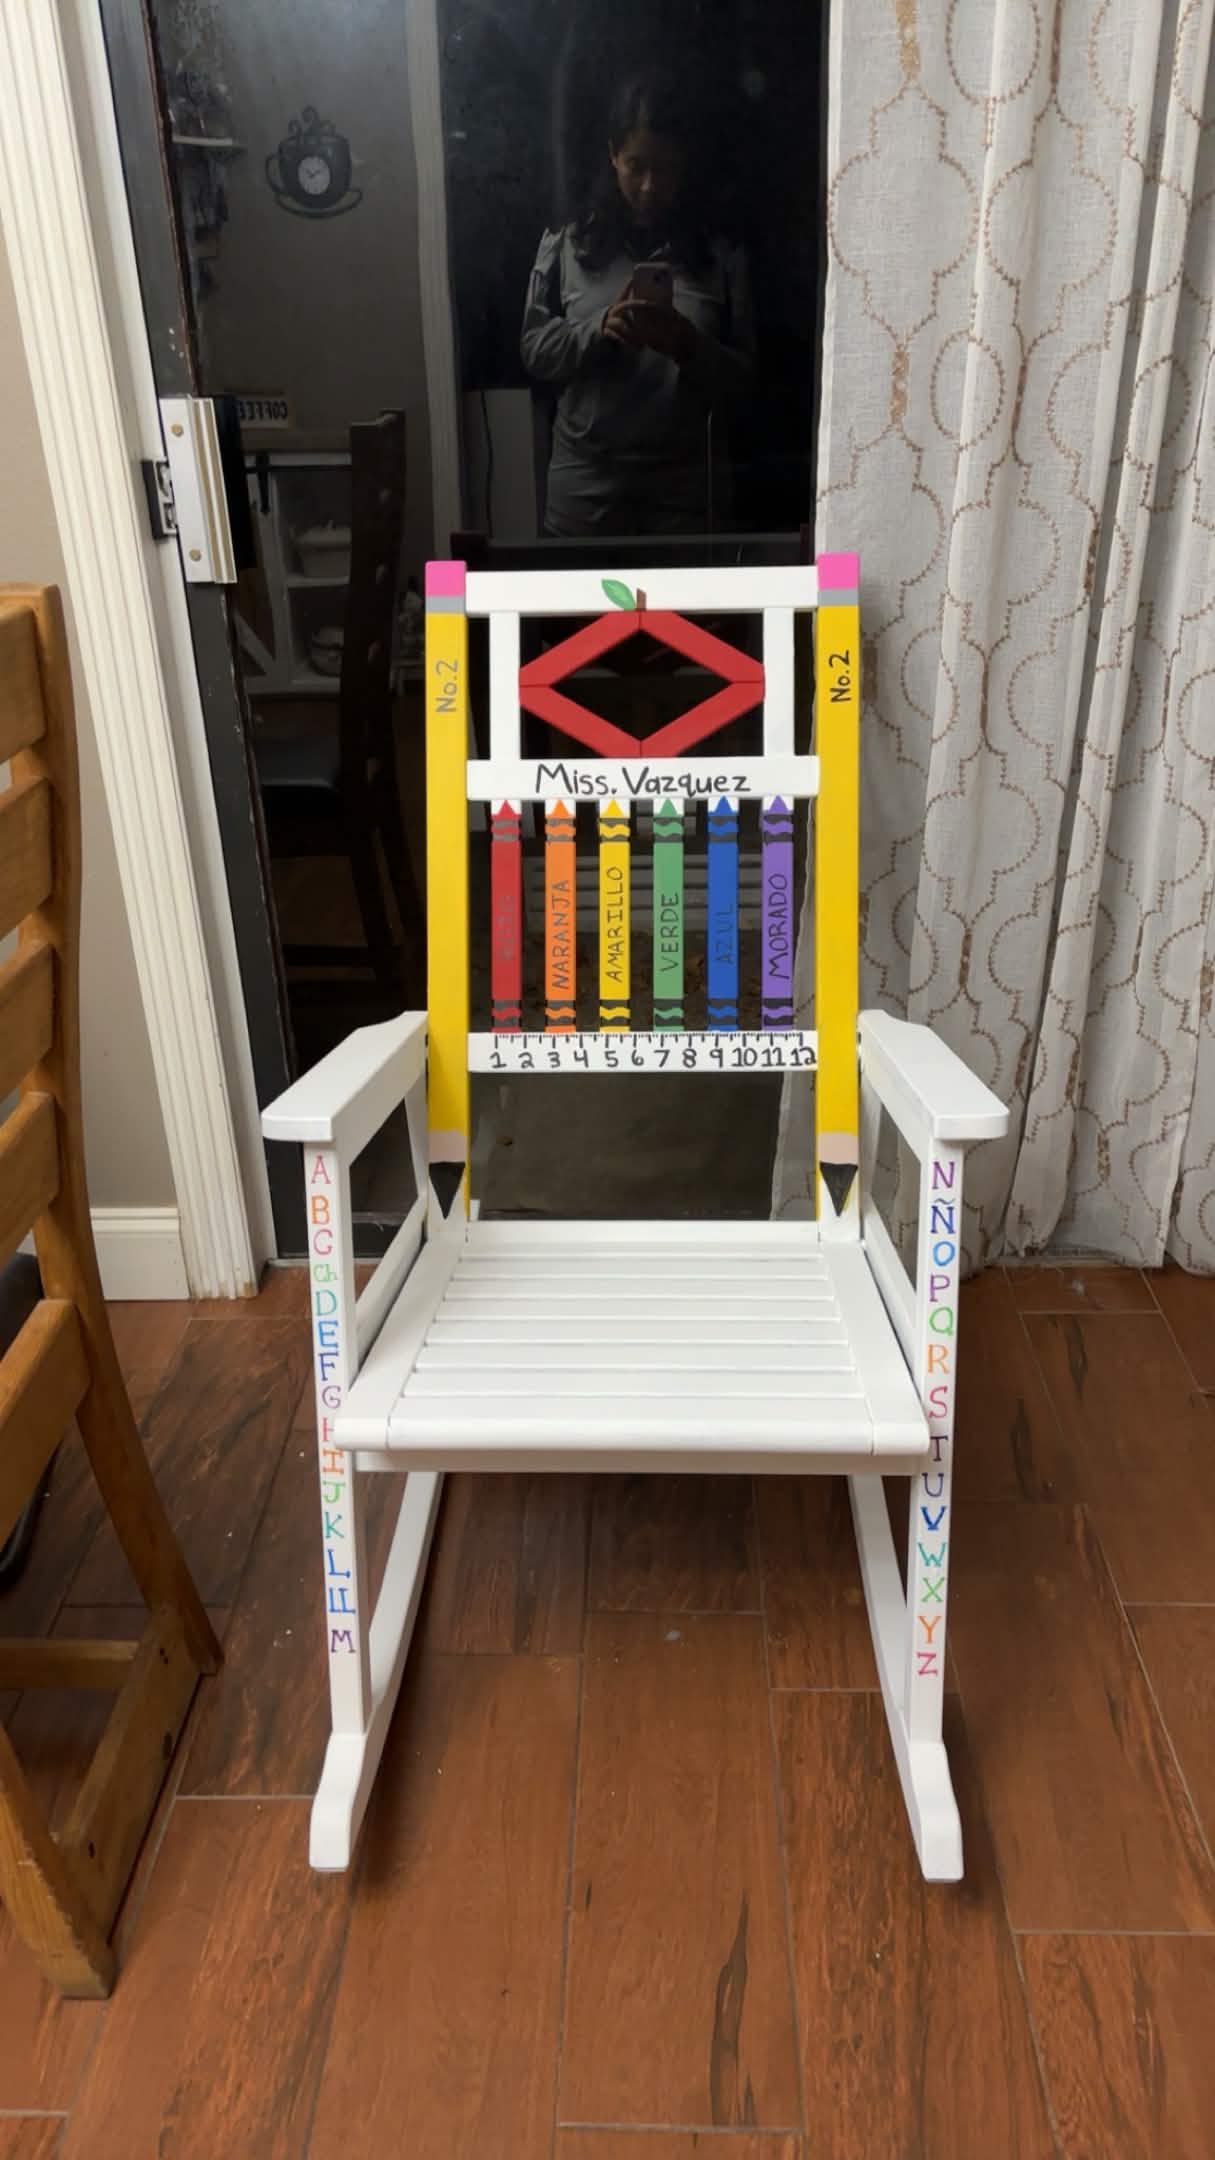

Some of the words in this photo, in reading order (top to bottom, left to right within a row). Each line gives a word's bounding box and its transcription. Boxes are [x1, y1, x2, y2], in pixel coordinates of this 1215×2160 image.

[435, 659, 458, 713] No.2
[829, 650, 851, 702] No.2
[535, 763, 618, 795] Miss.
[622, 767, 751, 799] Vazquez
[551, 879, 571, 989] NARANJA
[604, 866, 625, 982] AMARILLO
[660, 893, 680, 972] VERDE
[712, 904, 735, 964] AZUL
[768, 873, 790, 980] MORADO
[491, 1050, 507, 1068] 1
[519, 1050, 535, 1068] 2
[549, 1050, 562, 1068] 3
[574, 1049, 589, 1068] 4
[604, 1049, 619, 1067] 5
[631, 1049, 645, 1066] 6
[653, 1049, 671, 1067] 7
[682, 1049, 697, 1067] 8
[709, 1049, 724, 1068] 9
[731, 1049, 759, 1067] 10
[761, 1048, 787, 1067] 11
[790, 1048, 818, 1066] 12
[311, 1155, 331, 1184] A
[932, 1161, 955, 1189] N
[311, 1195, 330, 1225] B
[930, 1198, 956, 1234] Ñ
[932, 1241, 955, 1266] O
[929, 1275, 950, 1302] P
[315, 1290, 337, 1316] D
[318, 1320, 339, 1348] E
[929, 1306, 953, 1336] Q
[318, 1352, 339, 1382] F
[927, 1344, 949, 1374] R
[322, 1385, 342, 1409] G
[928, 1386, 948, 1418] S
[322, 1447, 344, 1474] I
[930, 1435, 948, 1462] T
[322, 1481, 345, 1504] J
[922, 1473, 944, 1497] U
[325, 1512, 344, 1538] K
[920, 1506, 947, 1531] V
[327, 1549, 351, 1578] L
[917, 1542, 947, 1567] W
[921, 1577, 945, 1602] X
[331, 1629, 356, 1653] M
[917, 1615, 942, 1644] Y
[916, 1652, 938, 1675] Z
